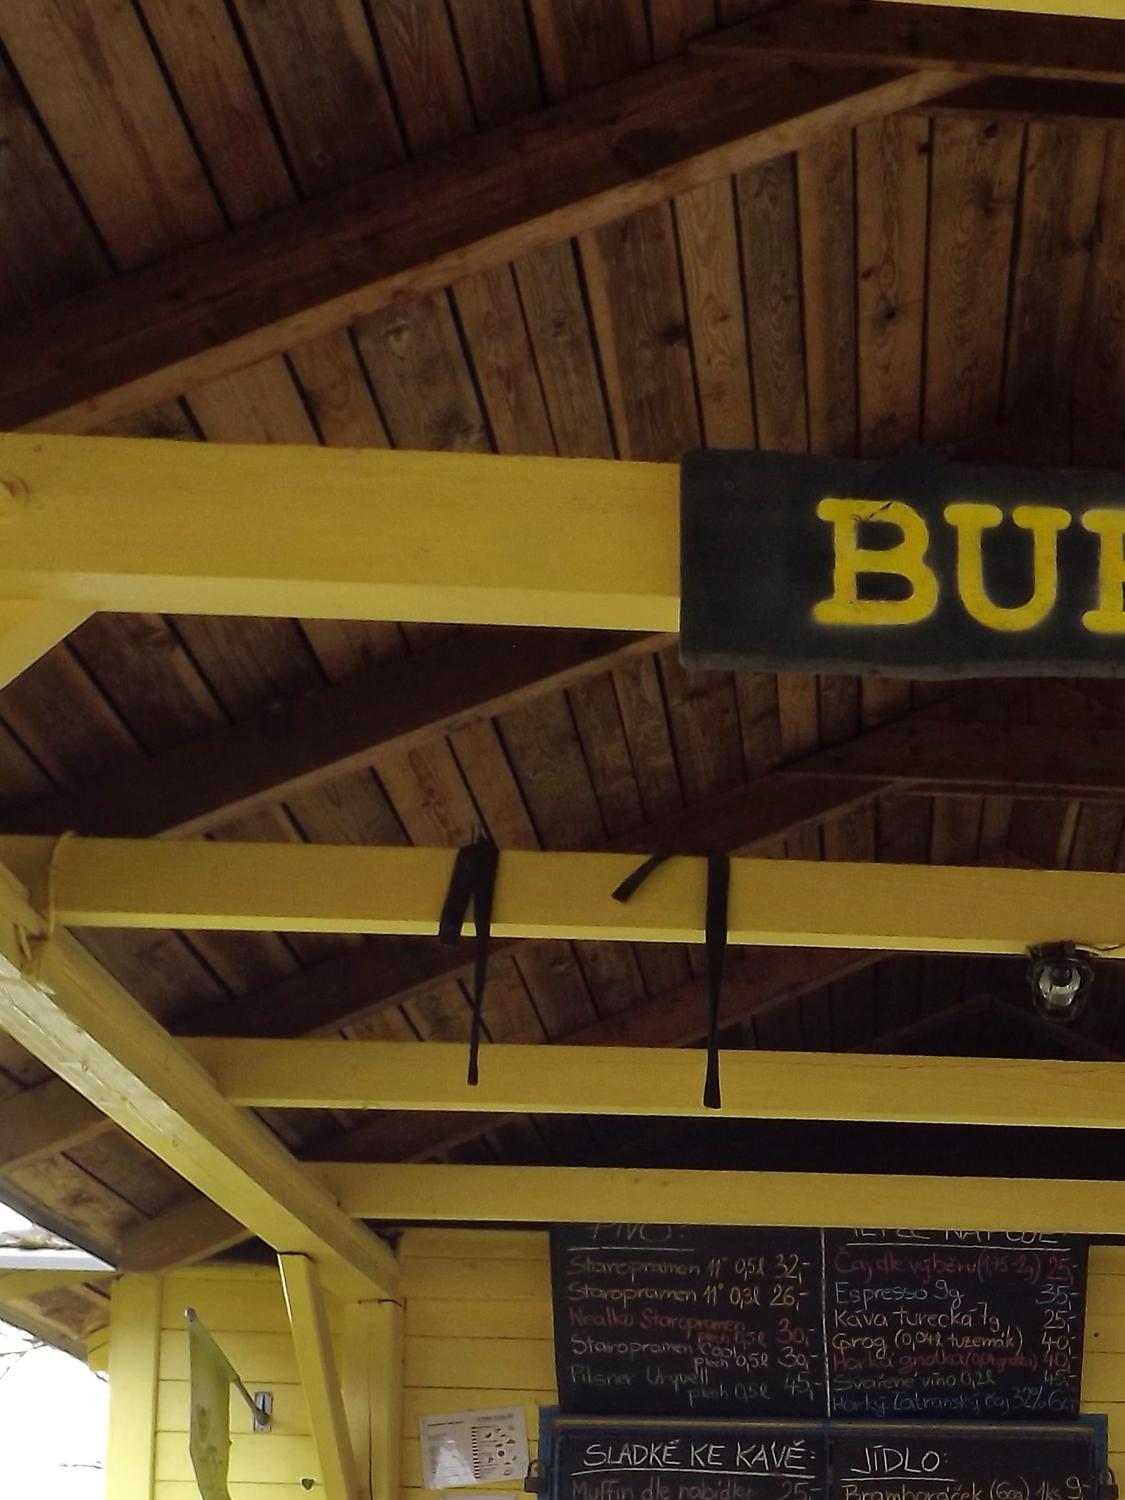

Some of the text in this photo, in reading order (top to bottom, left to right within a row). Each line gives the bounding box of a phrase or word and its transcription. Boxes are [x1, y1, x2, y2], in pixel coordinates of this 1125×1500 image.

[568, 1256, 699, 1282] Staropramen
[568, 1282, 697, 1308] Staropramen
[833, 1280, 928, 1310] Espresso
[934, 1279, 964, 1309] 9g
[570, 1335, 693, 1361] Staropramen
[831, 1332, 886, 1360] Grog
[583, 1438, 681, 1467] SLADKÉ
[690, 1442, 726, 1468] KE
[641, 1476, 671, 1500] dle
